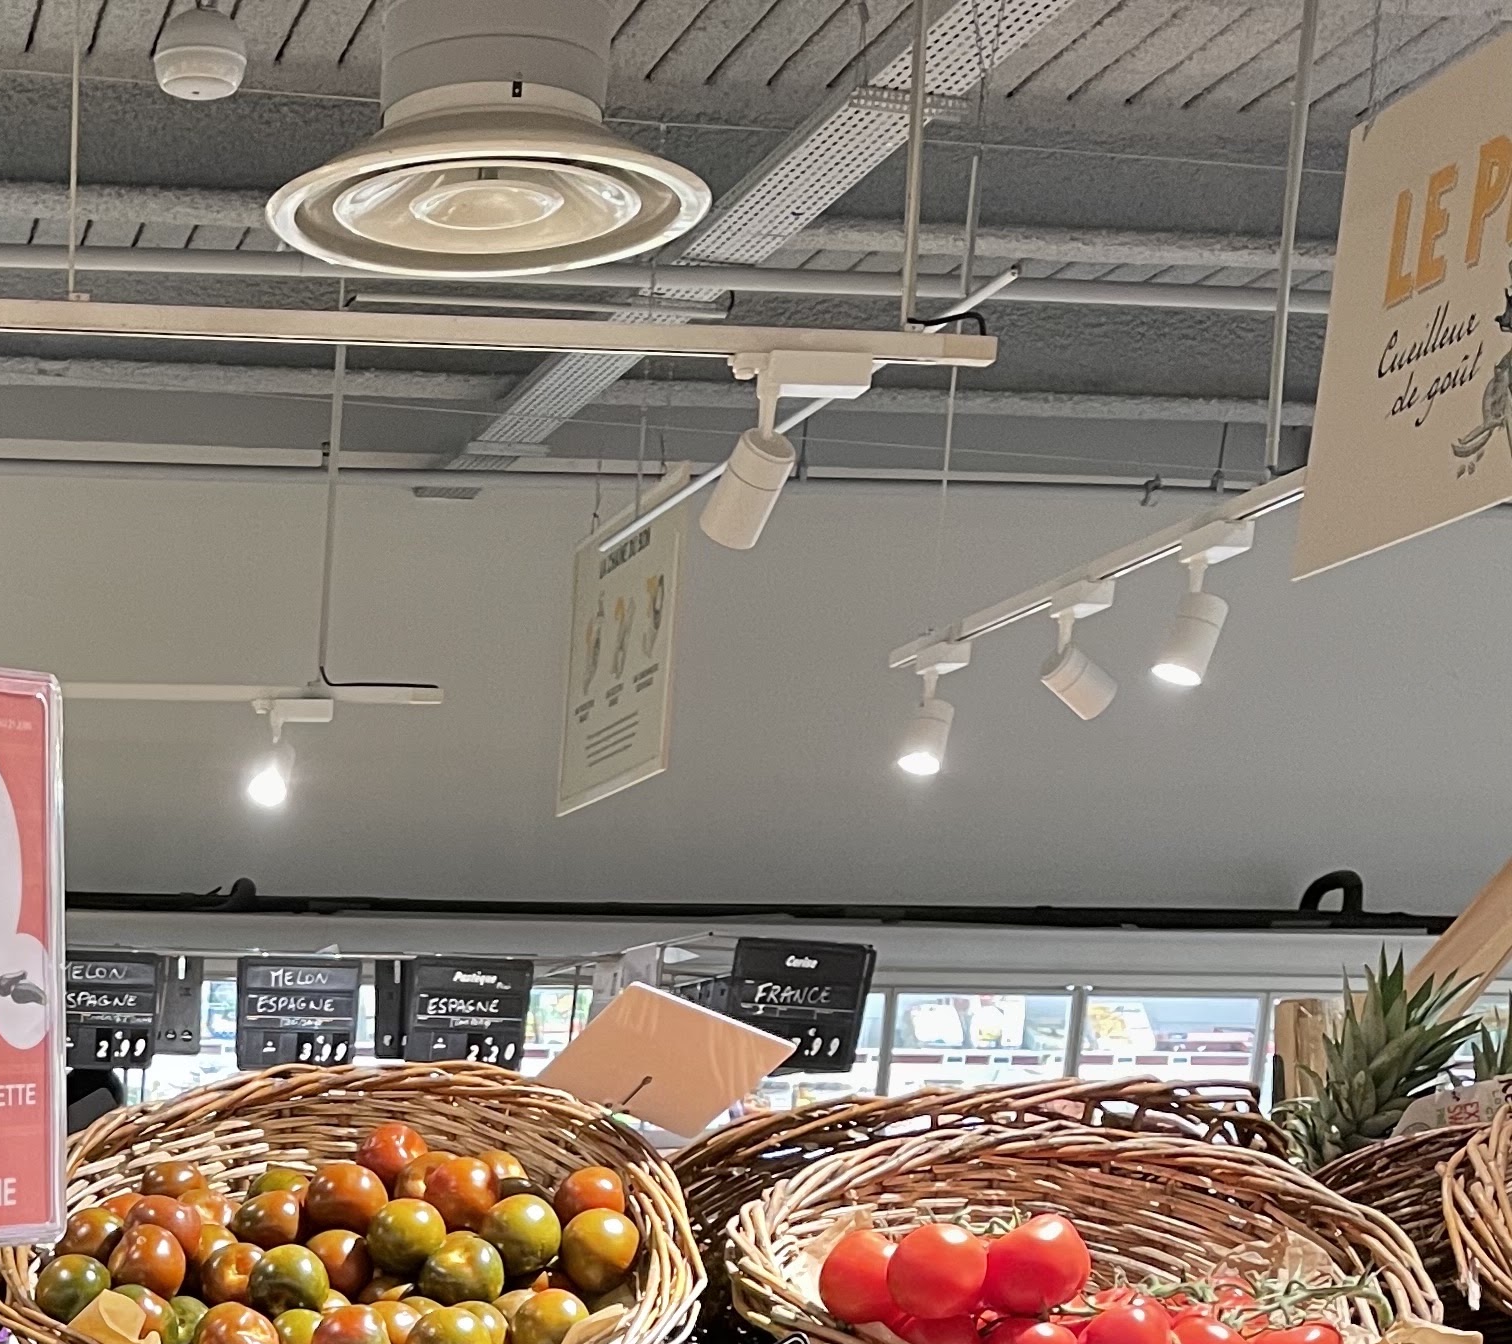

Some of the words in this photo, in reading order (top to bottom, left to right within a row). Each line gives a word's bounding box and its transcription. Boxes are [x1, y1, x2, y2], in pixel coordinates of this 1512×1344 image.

[1382, 162, 1459, 310] LE
[1464, 134, 1512, 269] P
[1387, 370, 1419, 418] de
[1414, 341, 1484, 428] goût
[269, 968, 329, 988] MELON
[65, 991, 138, 1008] SPAGNE
[754, 982, 832, 1004] FRANCE
[256, 995, 335, 1013] ESPAGNE
[427, 998, 500, 1015] ESPAGNE
